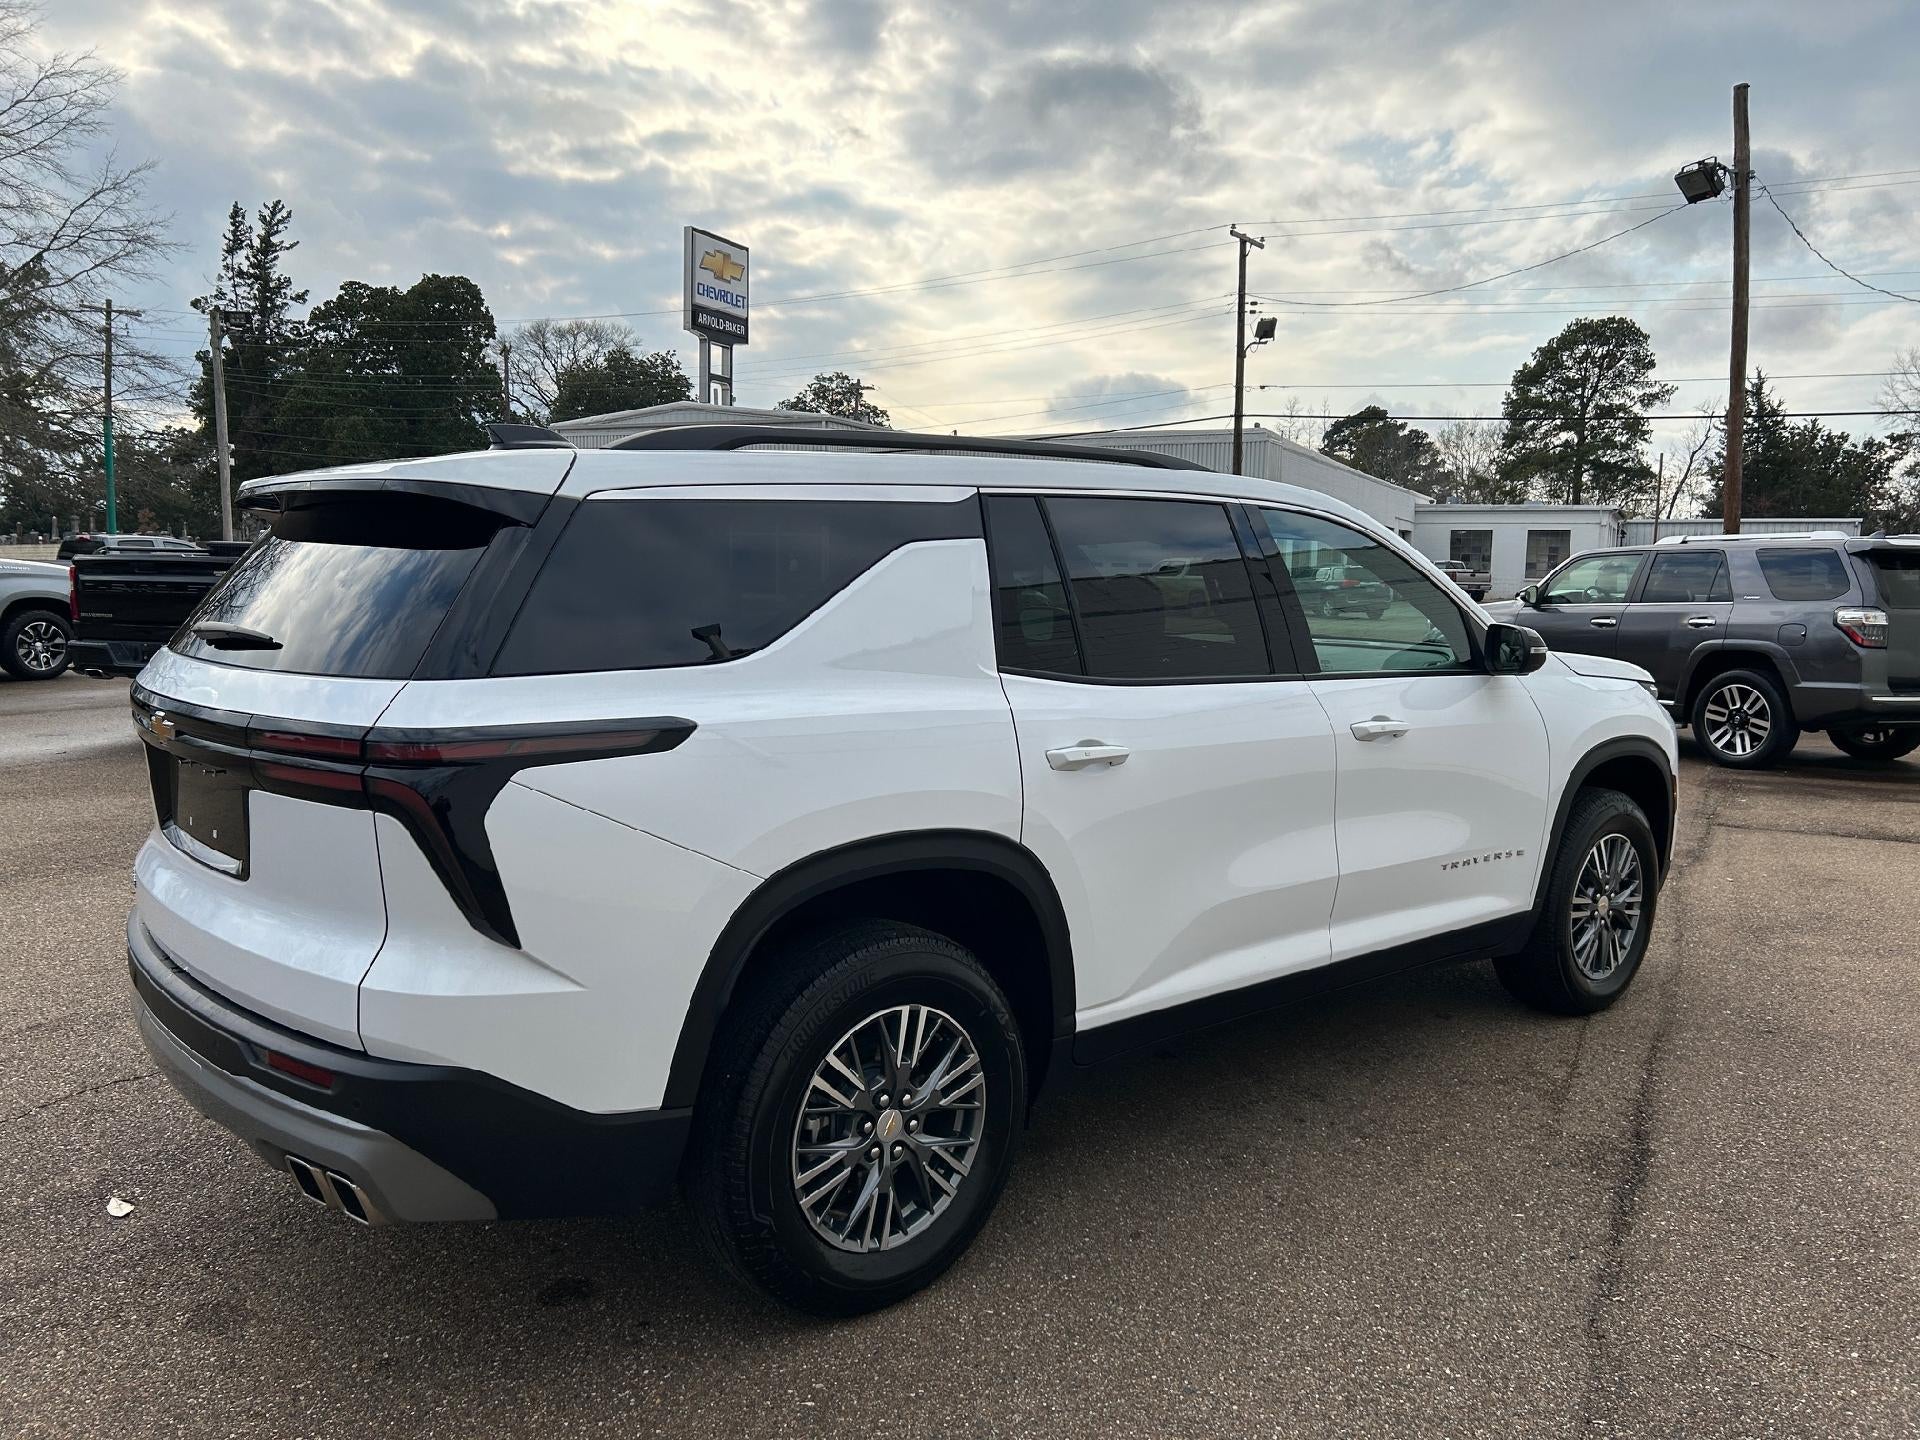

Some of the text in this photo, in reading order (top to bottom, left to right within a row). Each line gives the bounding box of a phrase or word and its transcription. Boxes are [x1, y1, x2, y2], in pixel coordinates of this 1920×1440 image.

[697, 282, 746, 309] CHEVROLET
[698, 312, 745, 335] ARNOLD-BAKER
[1441, 849, 1525, 871] TRAVERSE
